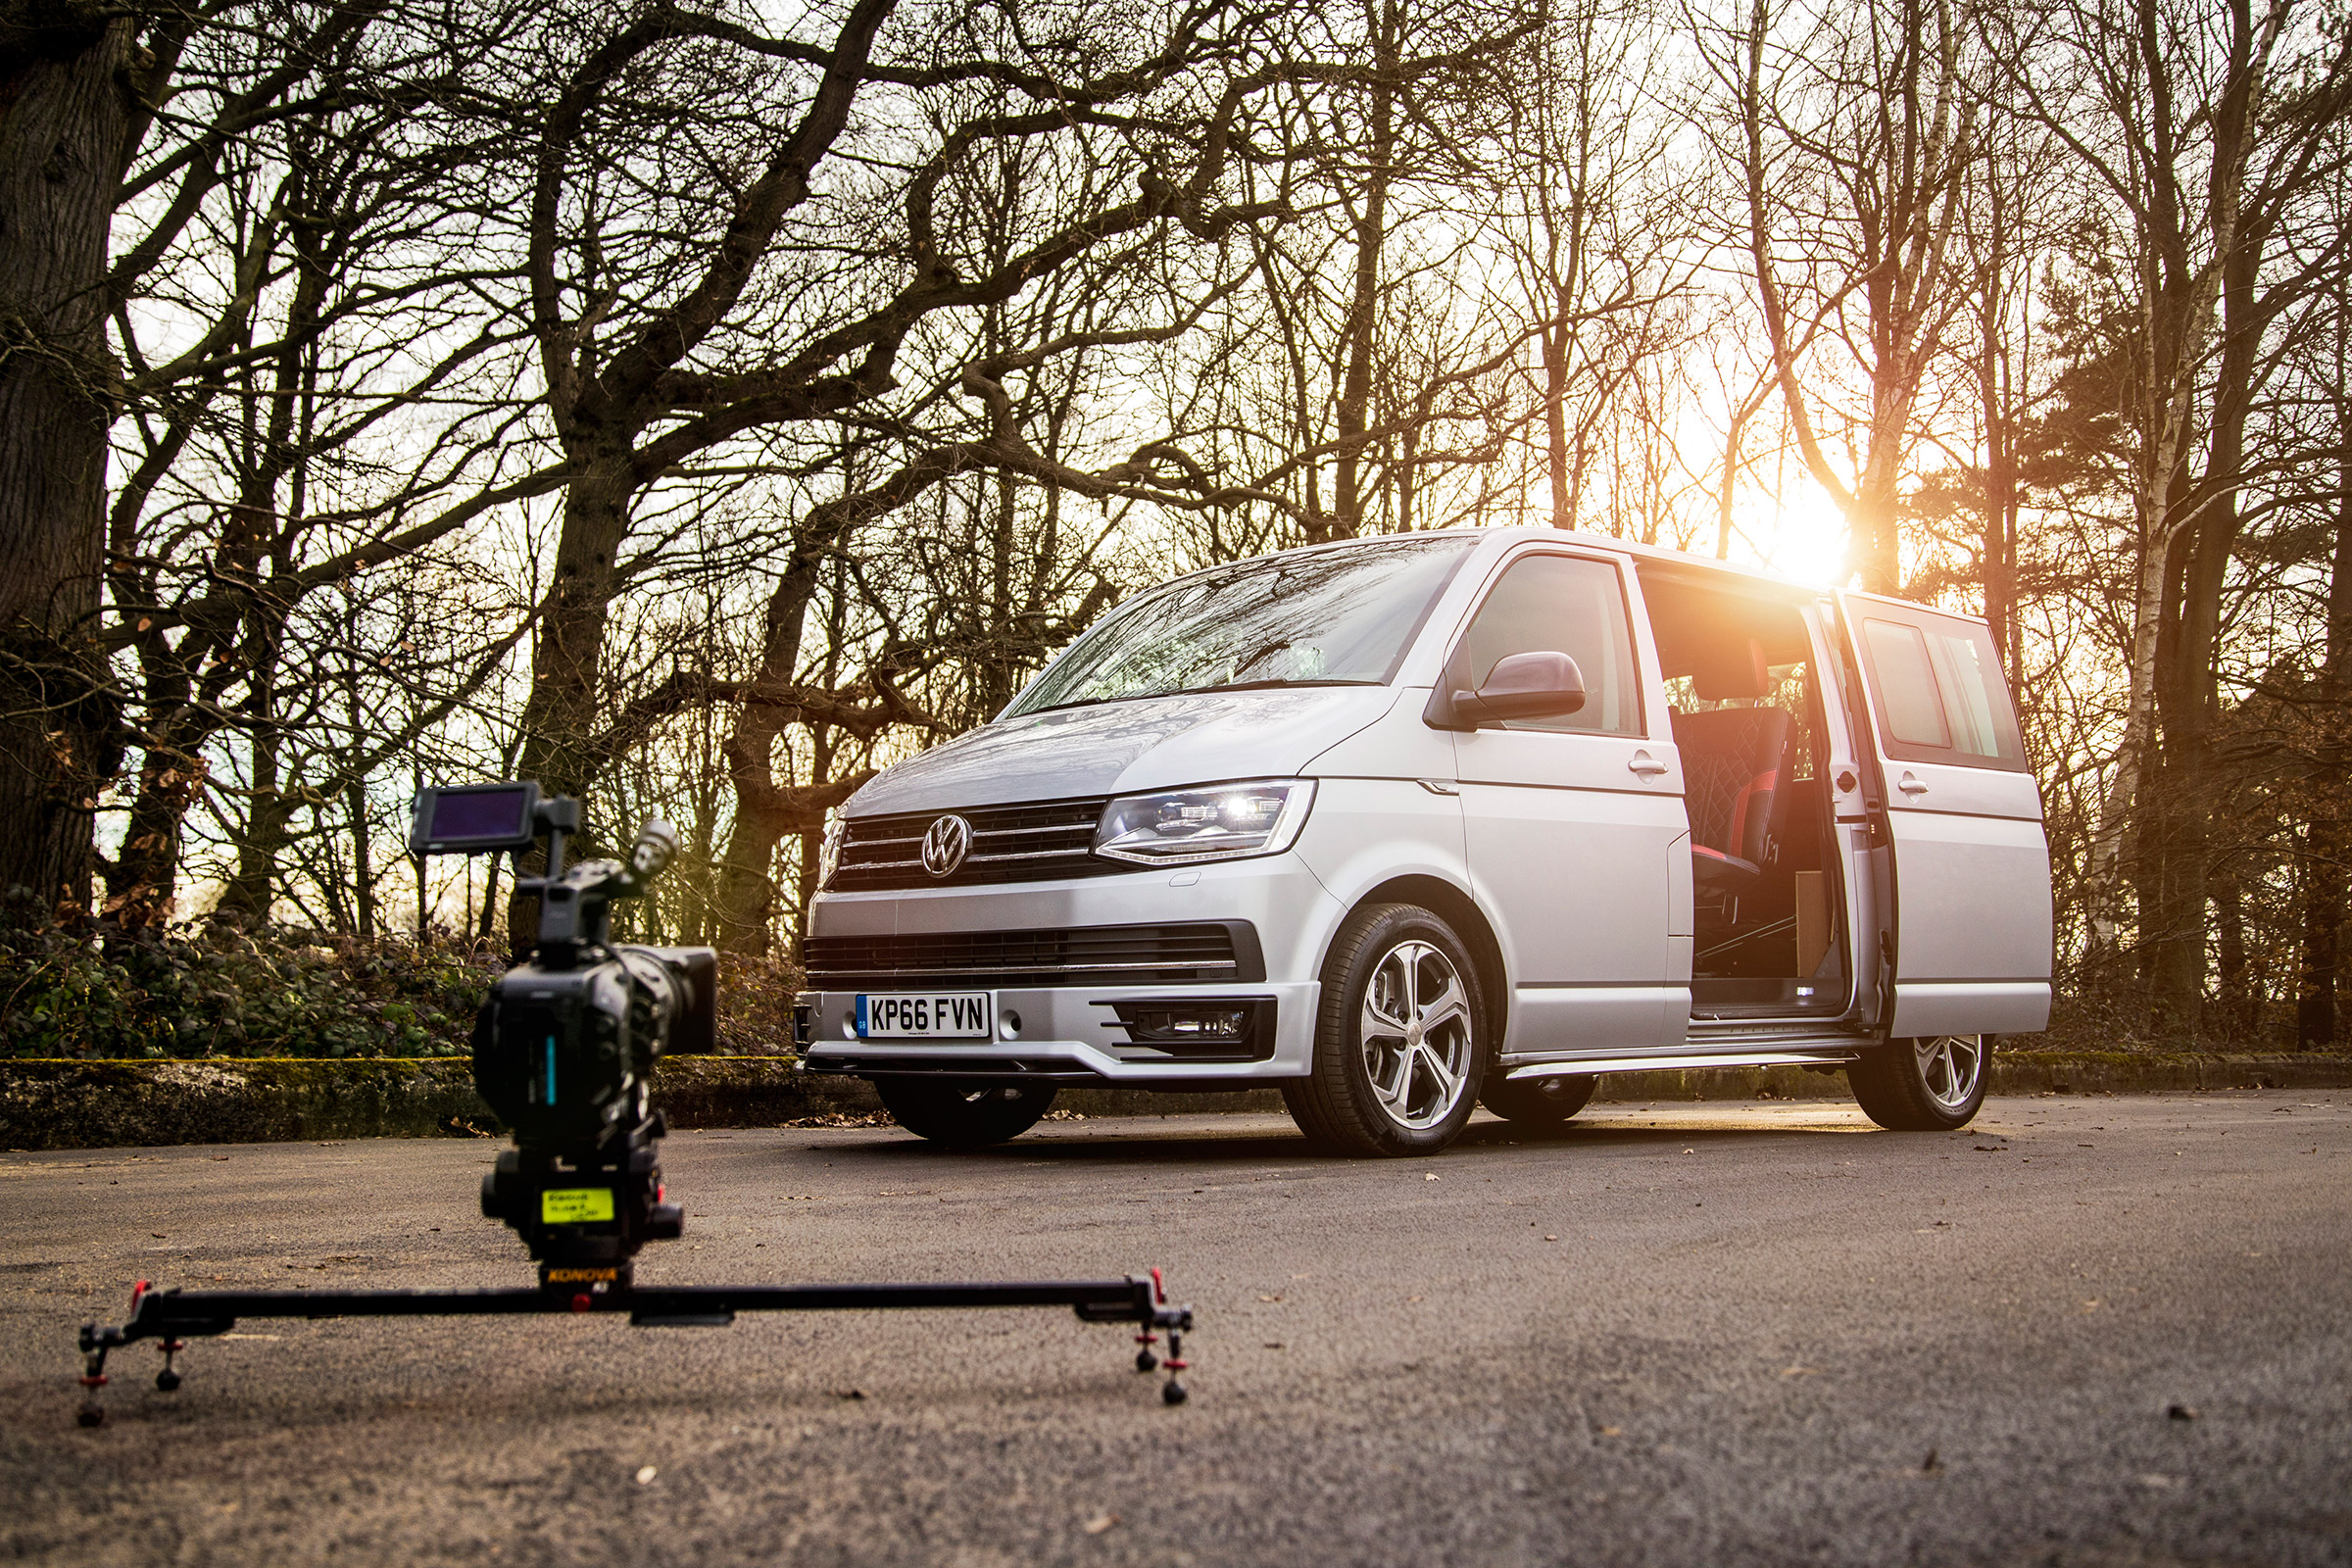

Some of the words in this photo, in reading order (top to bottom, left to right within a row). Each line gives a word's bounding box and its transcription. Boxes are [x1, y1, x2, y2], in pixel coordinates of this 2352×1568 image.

[922, 814, 967, 878] VW
[871, 999, 928, 1030] KP66
[935, 998, 983, 1030] FVN
